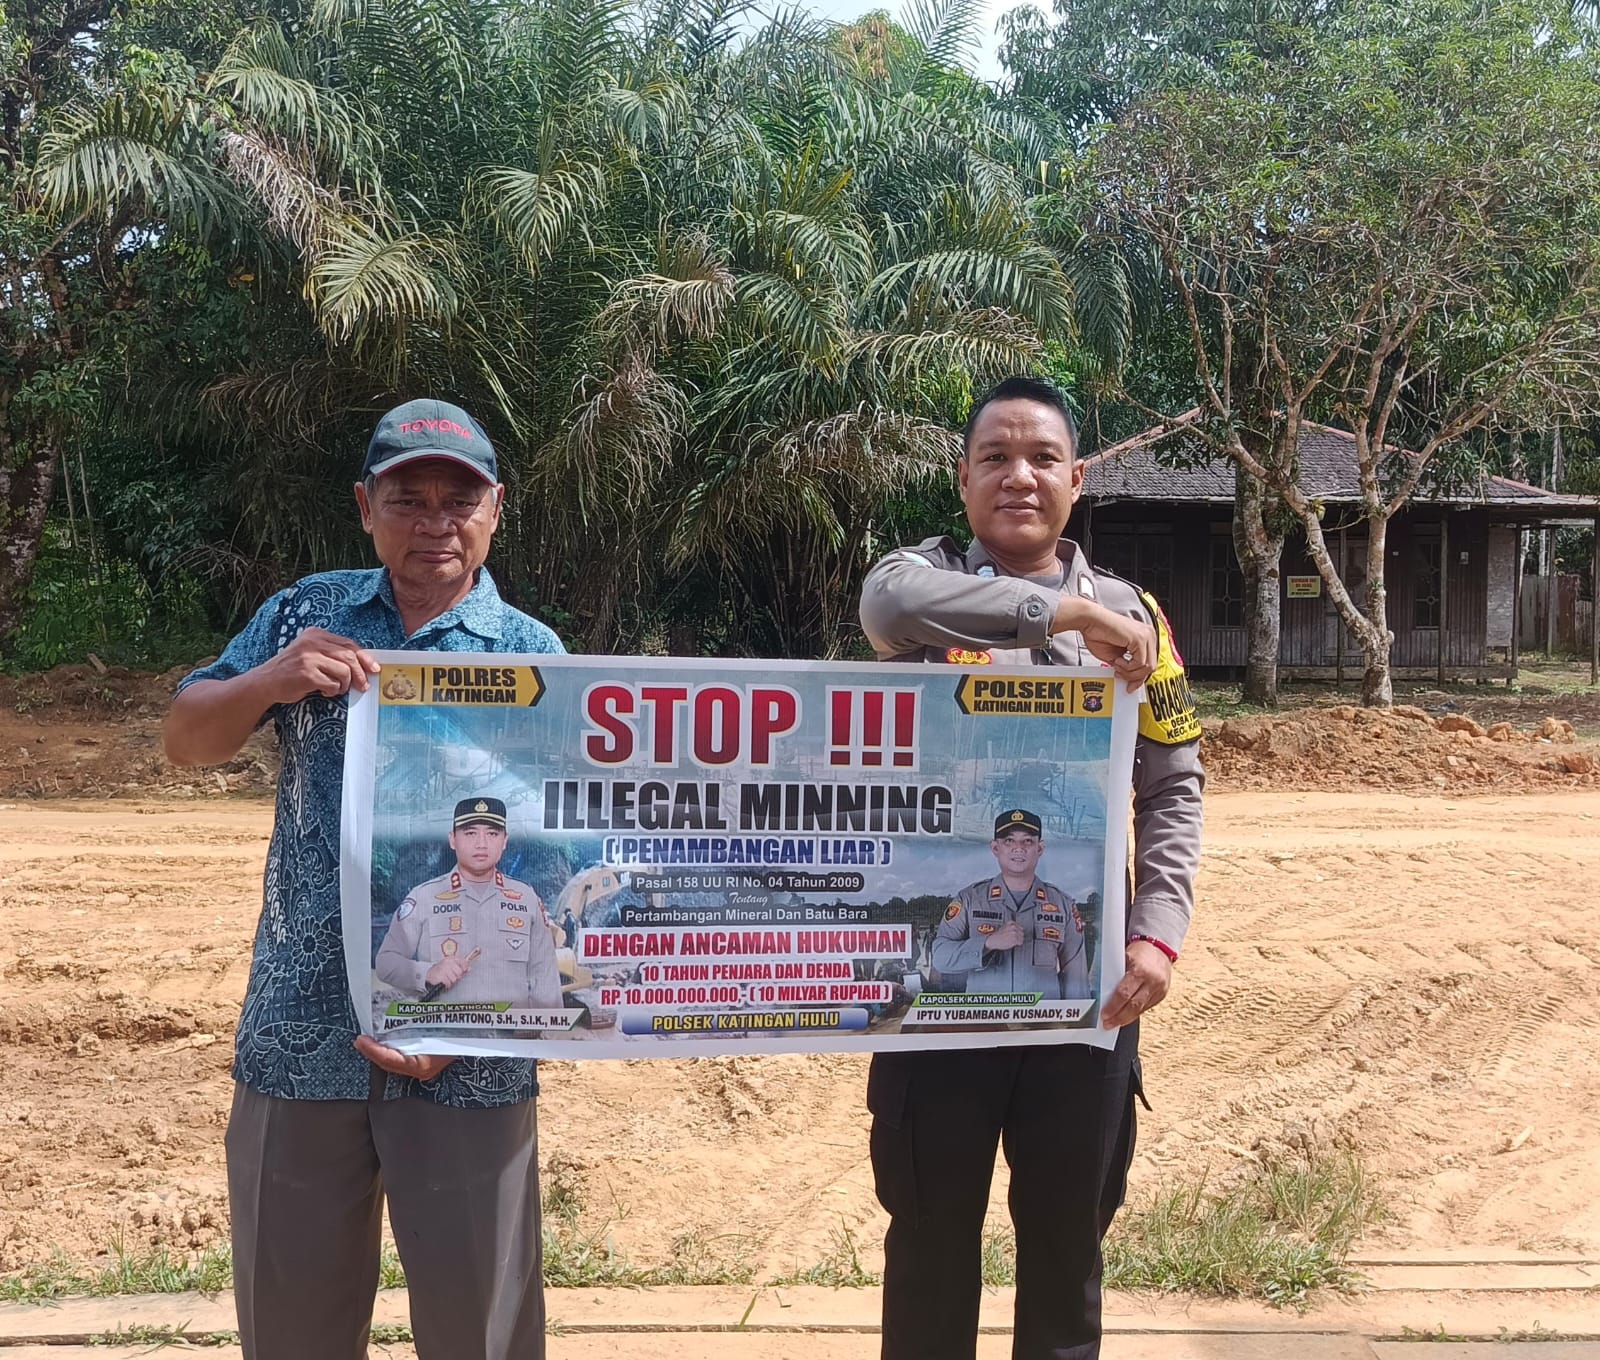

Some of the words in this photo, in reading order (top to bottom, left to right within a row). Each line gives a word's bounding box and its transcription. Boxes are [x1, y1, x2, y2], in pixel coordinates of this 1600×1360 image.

[398, 418, 474, 440] TOYOTA
[432, 667, 517, 687] POLRES
[432, 688, 517, 703] KATINGAN
[973, 679, 1065, 699] POLSEK
[973, 700, 1033, 713] KATINGAN
[1034, 701, 1065, 714] HULU
[584, 684, 798, 767] STOP
[829, 689, 917, 767] !!!
[542, 779, 728, 831] ILLEGAL
[738, 783, 953, 835] MINNING
[636, 876, 672, 889] Pasal
[676, 876, 698, 889] 158
[703, 876, 722, 888] UU
[726, 876, 739, 888] RI
[743, 876, 764, 888] No.
[768, 876, 784, 888] 04
[787, 876, 827, 888] Tahun
[830, 876, 860, 888] 2009
[728, 891, 769, 906] Tentang
[432, 903, 462, 914] DODIK
[500, 902, 528, 913] POLRI
[625, 910, 722, 924] Pertambangan
[726, 909, 773, 921] Mineral
[776, 909, 801, 920] Dan
[805, 908, 835, 920] Batu
[838, 908, 868, 919] Bara
[583, 932, 675, 957] DENGAN
[680, 930, 792, 955] ANCAMAN
[797, 929, 907, 954] HUKUMAN
[643, 965, 659, 981] 10
[663, 964, 709, 980] TAHUN
[712, 964, 772, 979] PENJARA
[775, 963, 802, 979] DAN
[806, 962, 851, 978] DENDA
[601, 989, 622, 1006] RP.
[778, 985, 826, 1000] MILYAR
[920, 996, 964, 1004] KAPOLSEK
[967, 995, 1010, 1004] KATINGAN
[1011, 995, 1035, 1003] HULU
[398, 1004, 445, 1013] KAPOLRES
[916, 1010, 941, 1021] IPTU
[944, 1009, 1010, 1020] YUBAMBANG
[1012, 1008, 1063, 1020] KUSNADY,
[1065, 1008, 1080, 1018] SH
[445, 1013, 494, 1026] HARTONO,
[550, 1016, 571, 1026] M.H.
[652, 1014, 714, 1030] POLSEK
[717, 1013, 797, 1028] KATINGAN
[800, 1012, 840, 1027] HULU
